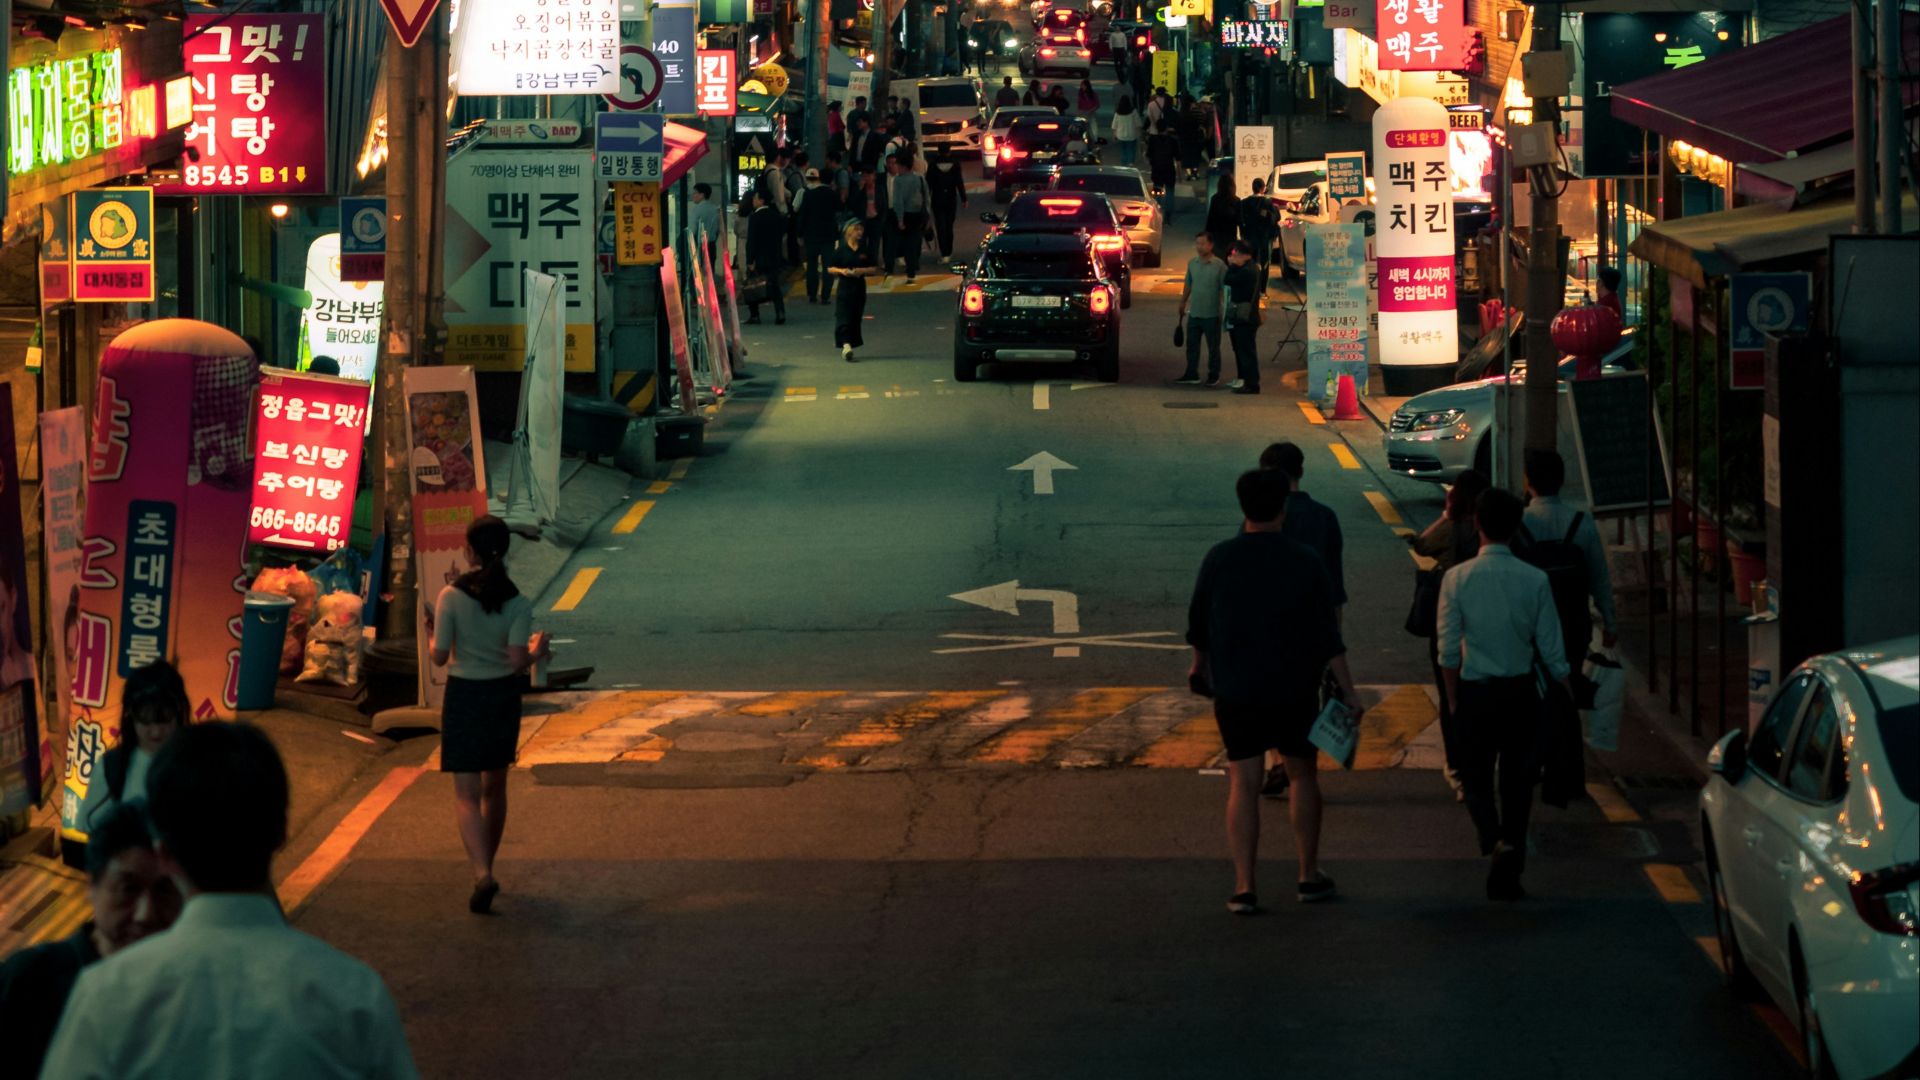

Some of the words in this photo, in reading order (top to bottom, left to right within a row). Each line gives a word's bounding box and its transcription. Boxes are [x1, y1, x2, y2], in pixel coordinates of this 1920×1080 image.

[1329, 5, 1358, 17] Bar
[511, 10, 616, 33] 오징어볶음
[1223, 22, 1284, 45] 마사지
[490, 38, 617, 60] 낙지곱창전골
[652, 40, 679, 54] 40
[1386, 31, 1443, 63] 맥주
[525, 72, 597, 88] 강남부두
[1449, 114, 1478, 128] BEER
[552, 126, 578, 136] DART
[1394, 132, 1440, 146] 단체환영
[600, 155, 659, 177] 일방통행
[1238, 154, 1271, 168] 부동산
[259, 166, 289, 183] B1
[470, 164, 518, 178] 70명이상
[520, 164, 554, 178] 단체석
[558, 164, 581, 178] 완비
[1389, 161, 1446, 193] 맥주
[622, 192, 653, 203] CCTV
[488, 193, 580, 240] 맥주
[1389, 202, 1446, 234] 치킨
[1388, 268, 1410, 283] 새벽
[1413, 266, 1450, 282] 4시까지
[1393, 284, 1447, 301] 영업합니다
[326, 327, 377, 345] 들어오세요
[456, 334, 510, 348] 다트게임
[261, 394, 364, 428] 정읍그맛!
[262, 440, 350, 470] 보신탕
[257, 472, 344, 500] 추어탕
[250, 506, 341, 537] 565-8545
